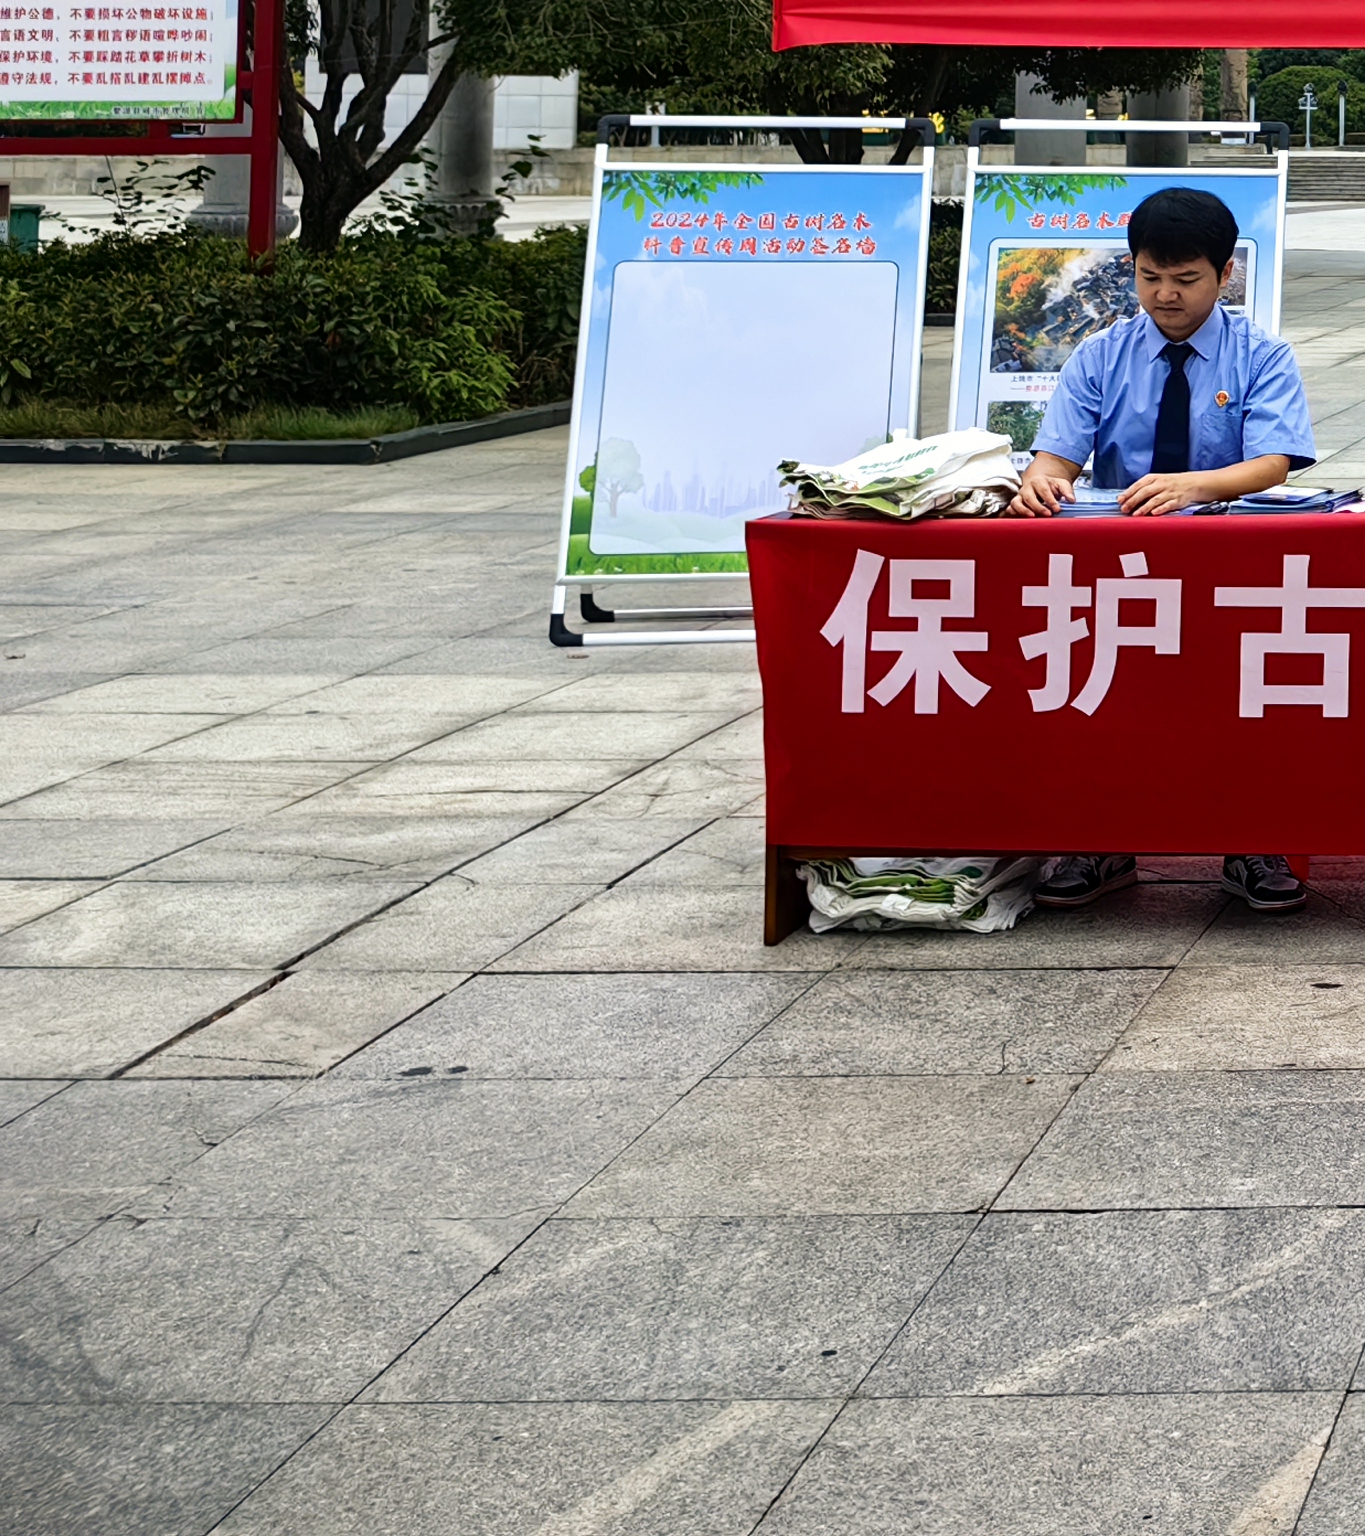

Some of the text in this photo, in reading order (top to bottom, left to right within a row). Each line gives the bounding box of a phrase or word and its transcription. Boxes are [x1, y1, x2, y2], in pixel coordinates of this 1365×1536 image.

[650, 211, 873, 231] 2024年全国古树名木
[643, 235, 878, 257] 科普宣传周活动签名墙
